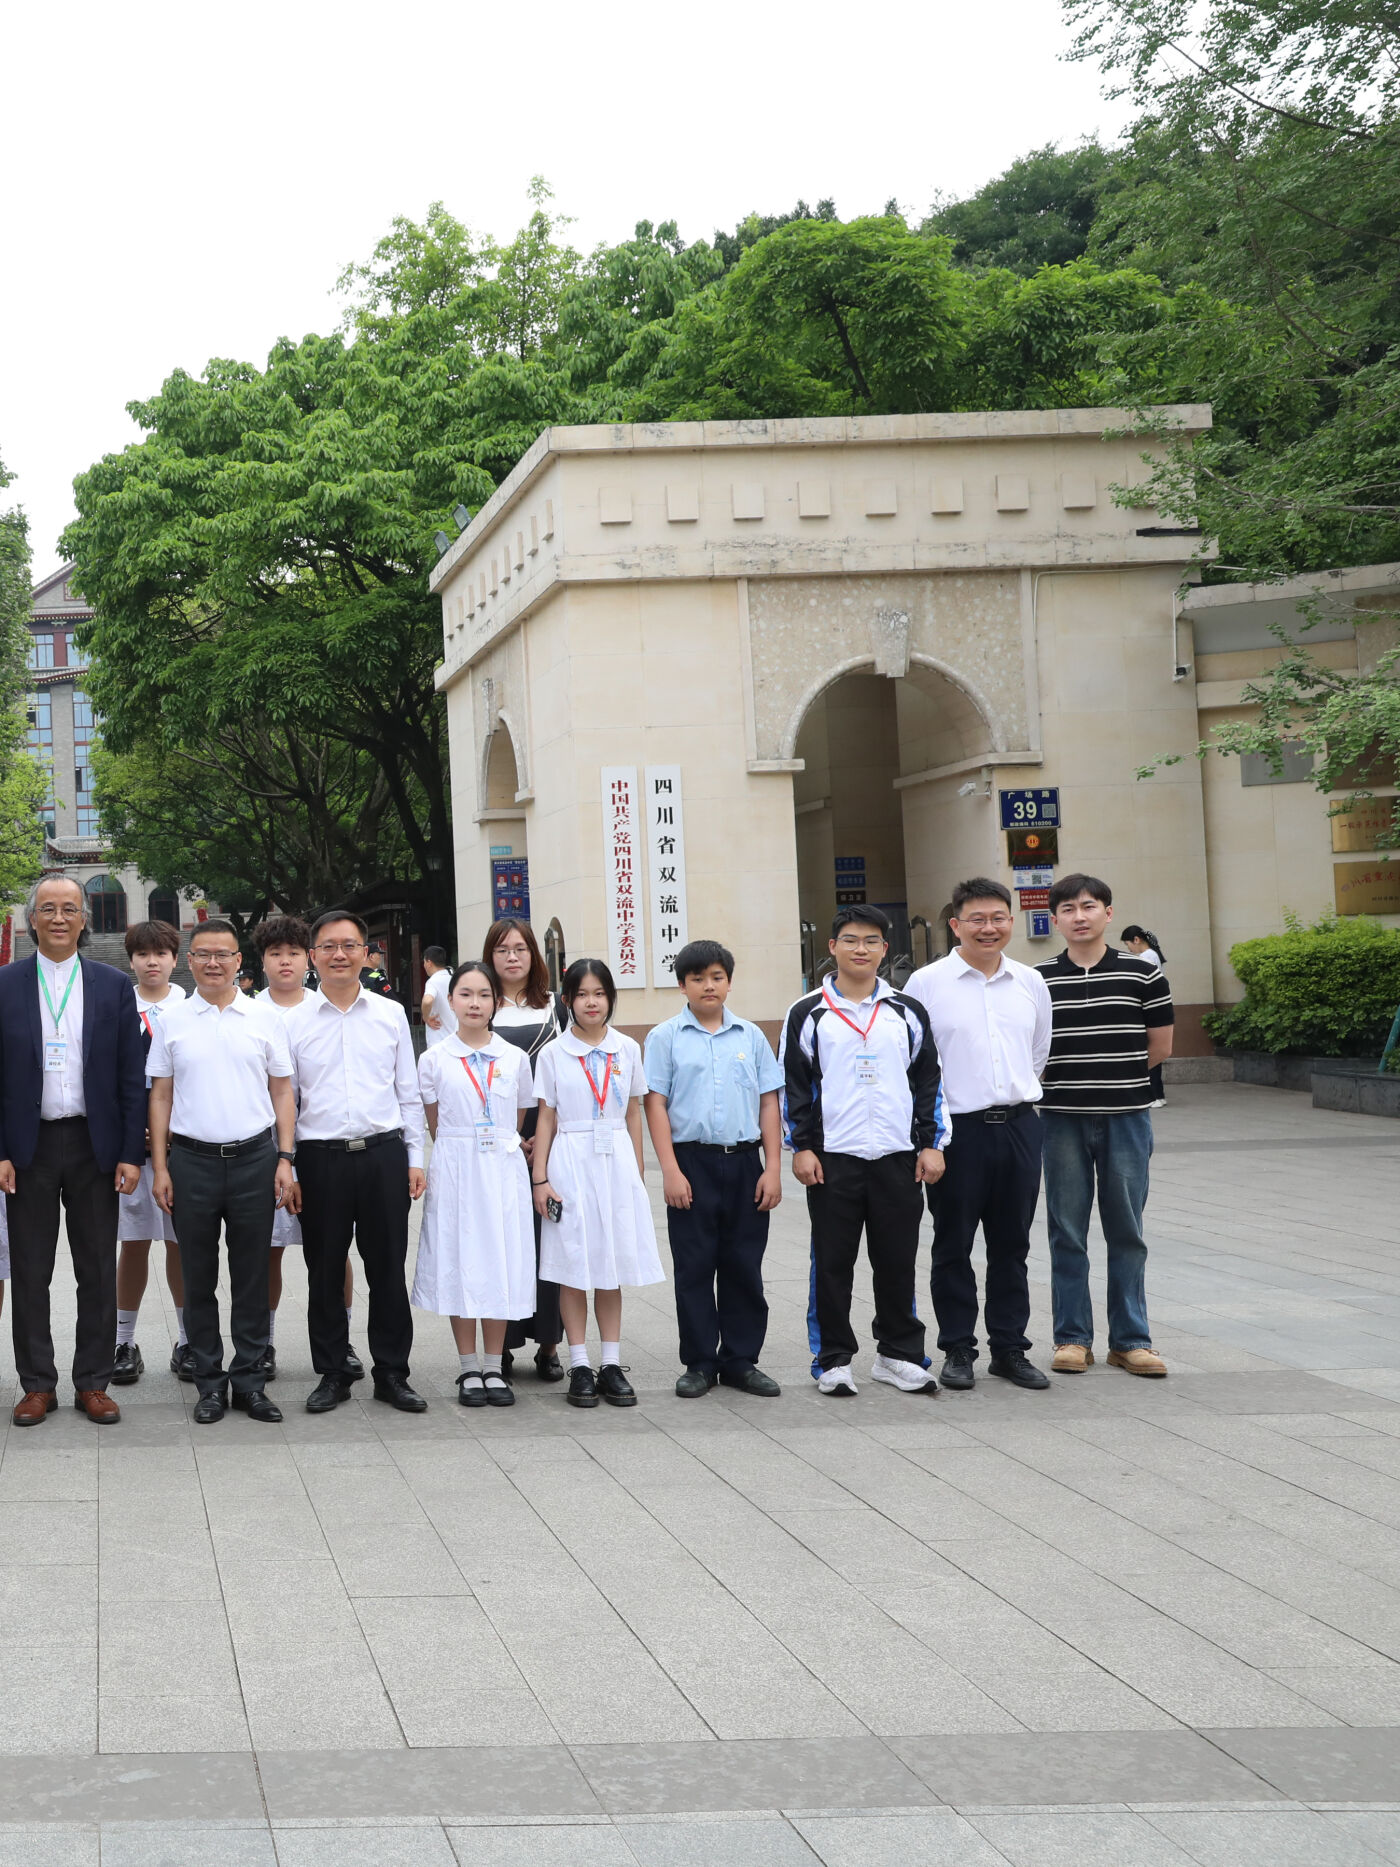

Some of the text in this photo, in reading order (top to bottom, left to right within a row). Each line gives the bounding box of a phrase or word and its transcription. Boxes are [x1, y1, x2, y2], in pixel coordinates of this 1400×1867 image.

[1007, 790, 1050, 800] 广场路
[1013, 801, 1037, 820] 39
[610, 780, 637, 975] 中国共产党四川省双流中学委员会
[655, 778, 679, 973] 四川省双流中学
